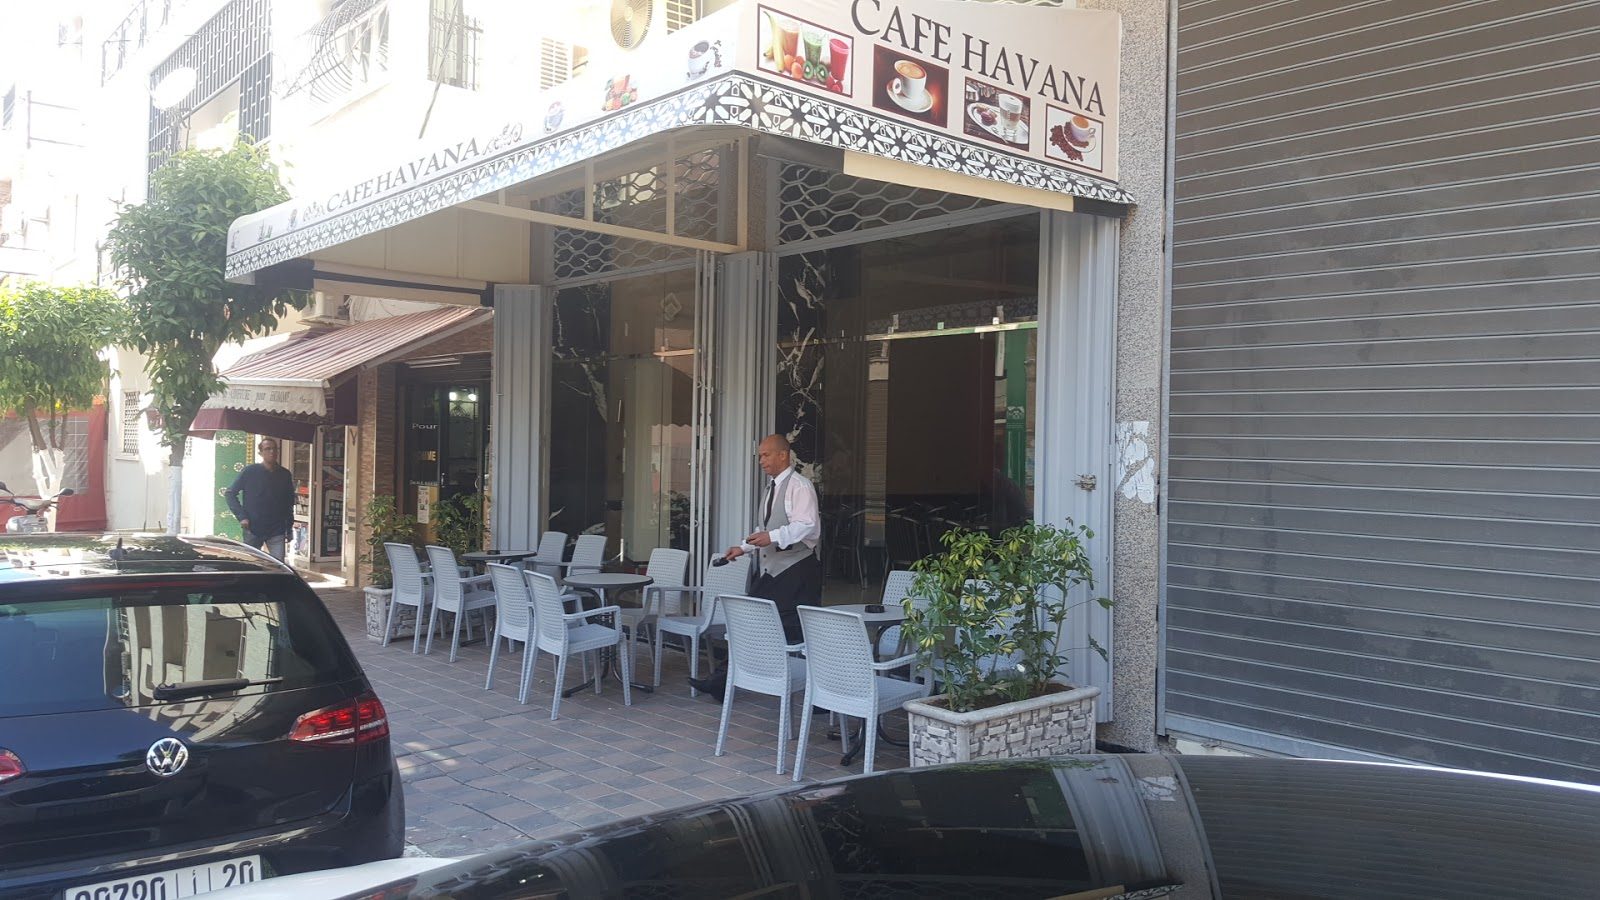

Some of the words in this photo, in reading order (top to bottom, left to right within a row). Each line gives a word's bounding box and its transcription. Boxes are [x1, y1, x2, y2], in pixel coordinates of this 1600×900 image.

[851, 0, 951, 64] CAFE
[960, 32, 1107, 118] HAVANA
[326, 181, 373, 213] CAFE
[373, 137, 481, 192] HAVANA
